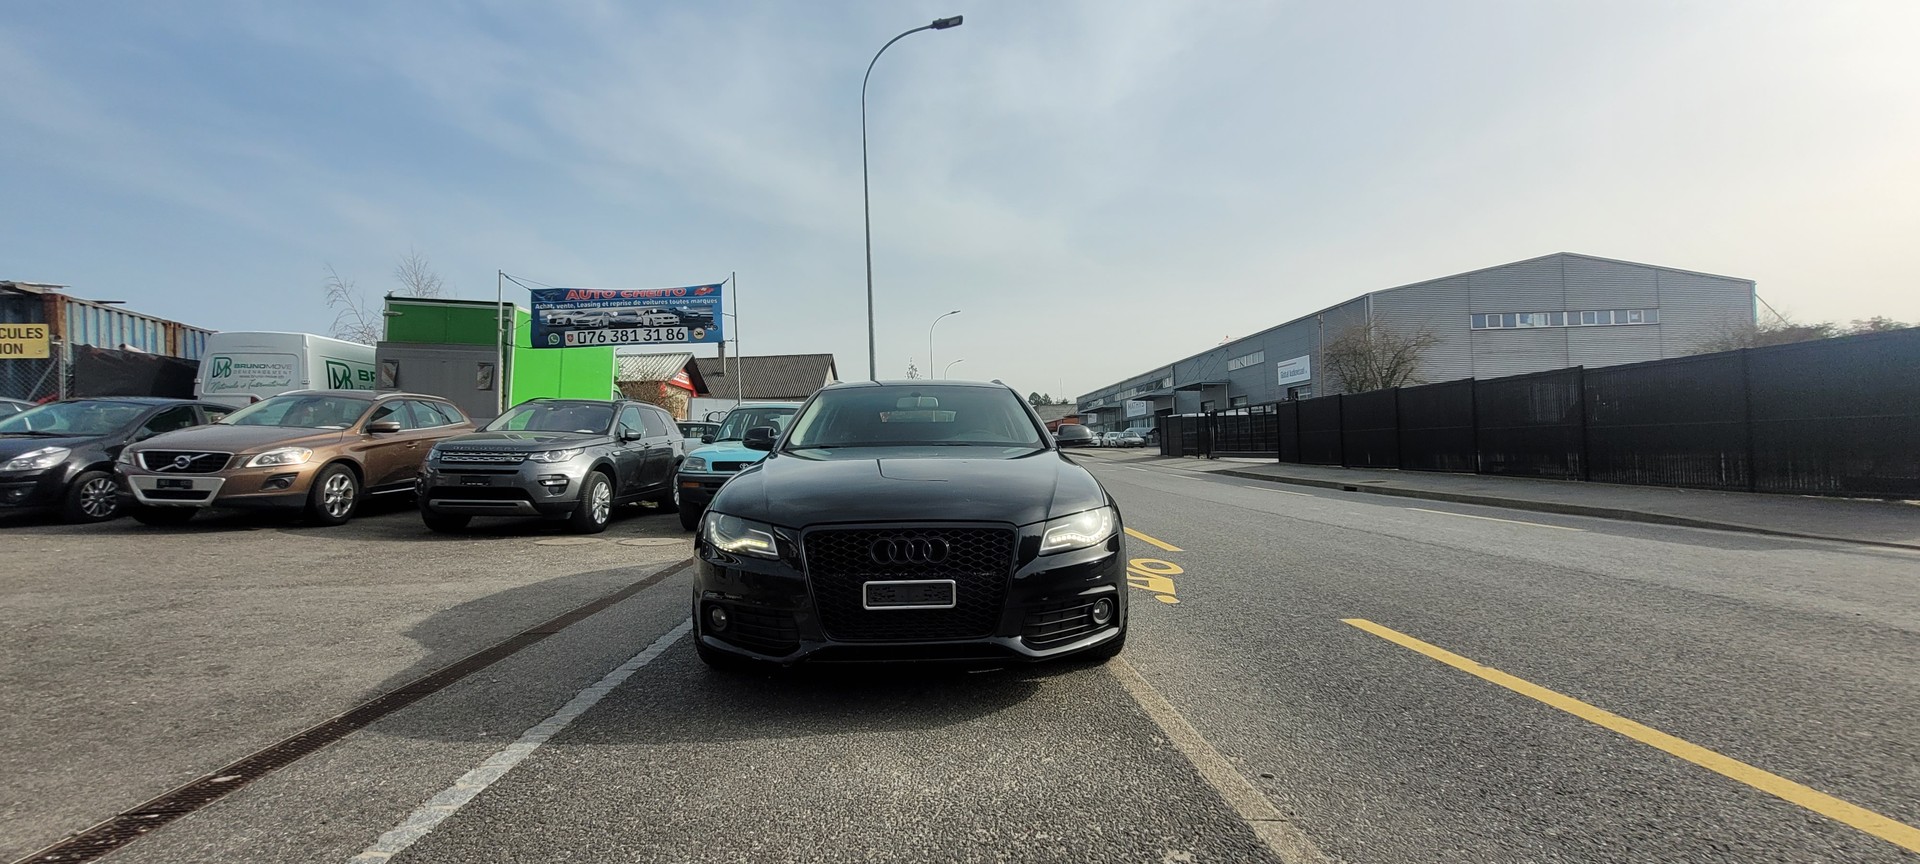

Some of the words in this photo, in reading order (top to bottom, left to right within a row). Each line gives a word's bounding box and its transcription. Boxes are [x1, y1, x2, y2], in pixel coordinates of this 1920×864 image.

[565, 289, 617, 300] AUTO
[576, 301, 601, 309] Leasing
[609, 299, 632, 307] reprise
[642, 298, 669, 306] voitures
[577, 330, 606, 344] 076
[610, 328, 640, 343] 381
[643, 328, 662, 342] 31
[666, 327, 685, 341] 86
